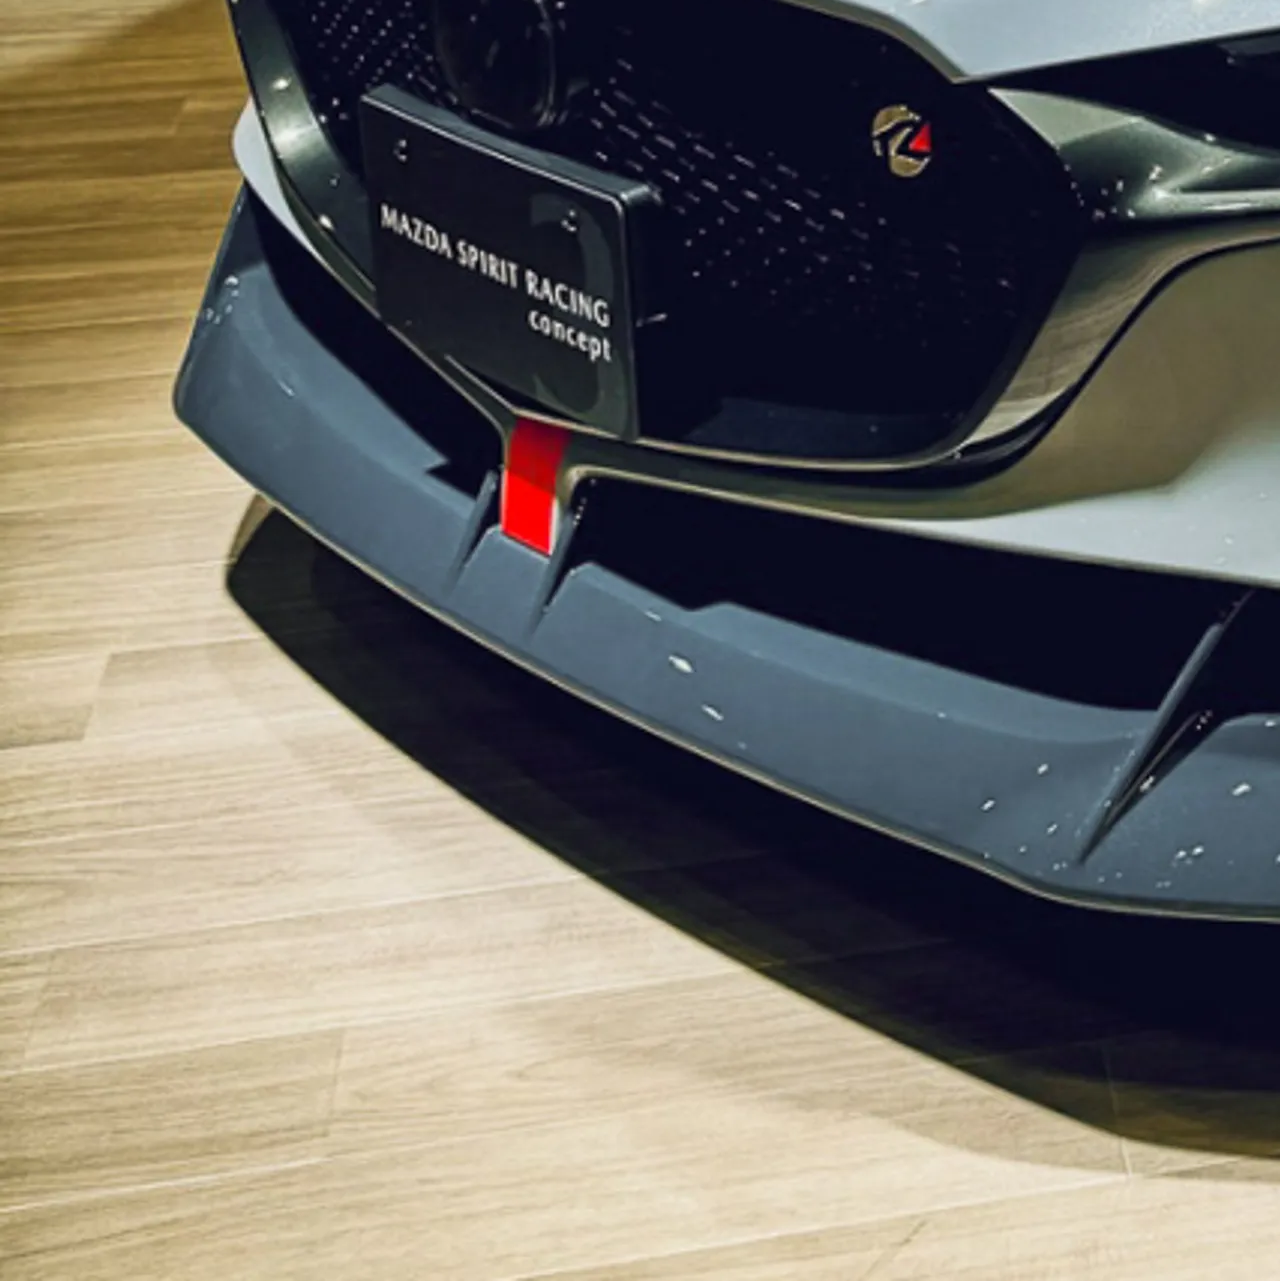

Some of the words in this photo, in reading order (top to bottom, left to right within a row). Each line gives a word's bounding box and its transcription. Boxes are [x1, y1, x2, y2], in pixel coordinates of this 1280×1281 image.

[380, 203, 453, 259] MAZDA
[456, 239, 518, 289] SPIRIT
[524, 269, 610, 328] RACING
[528, 309, 611, 362] concept
